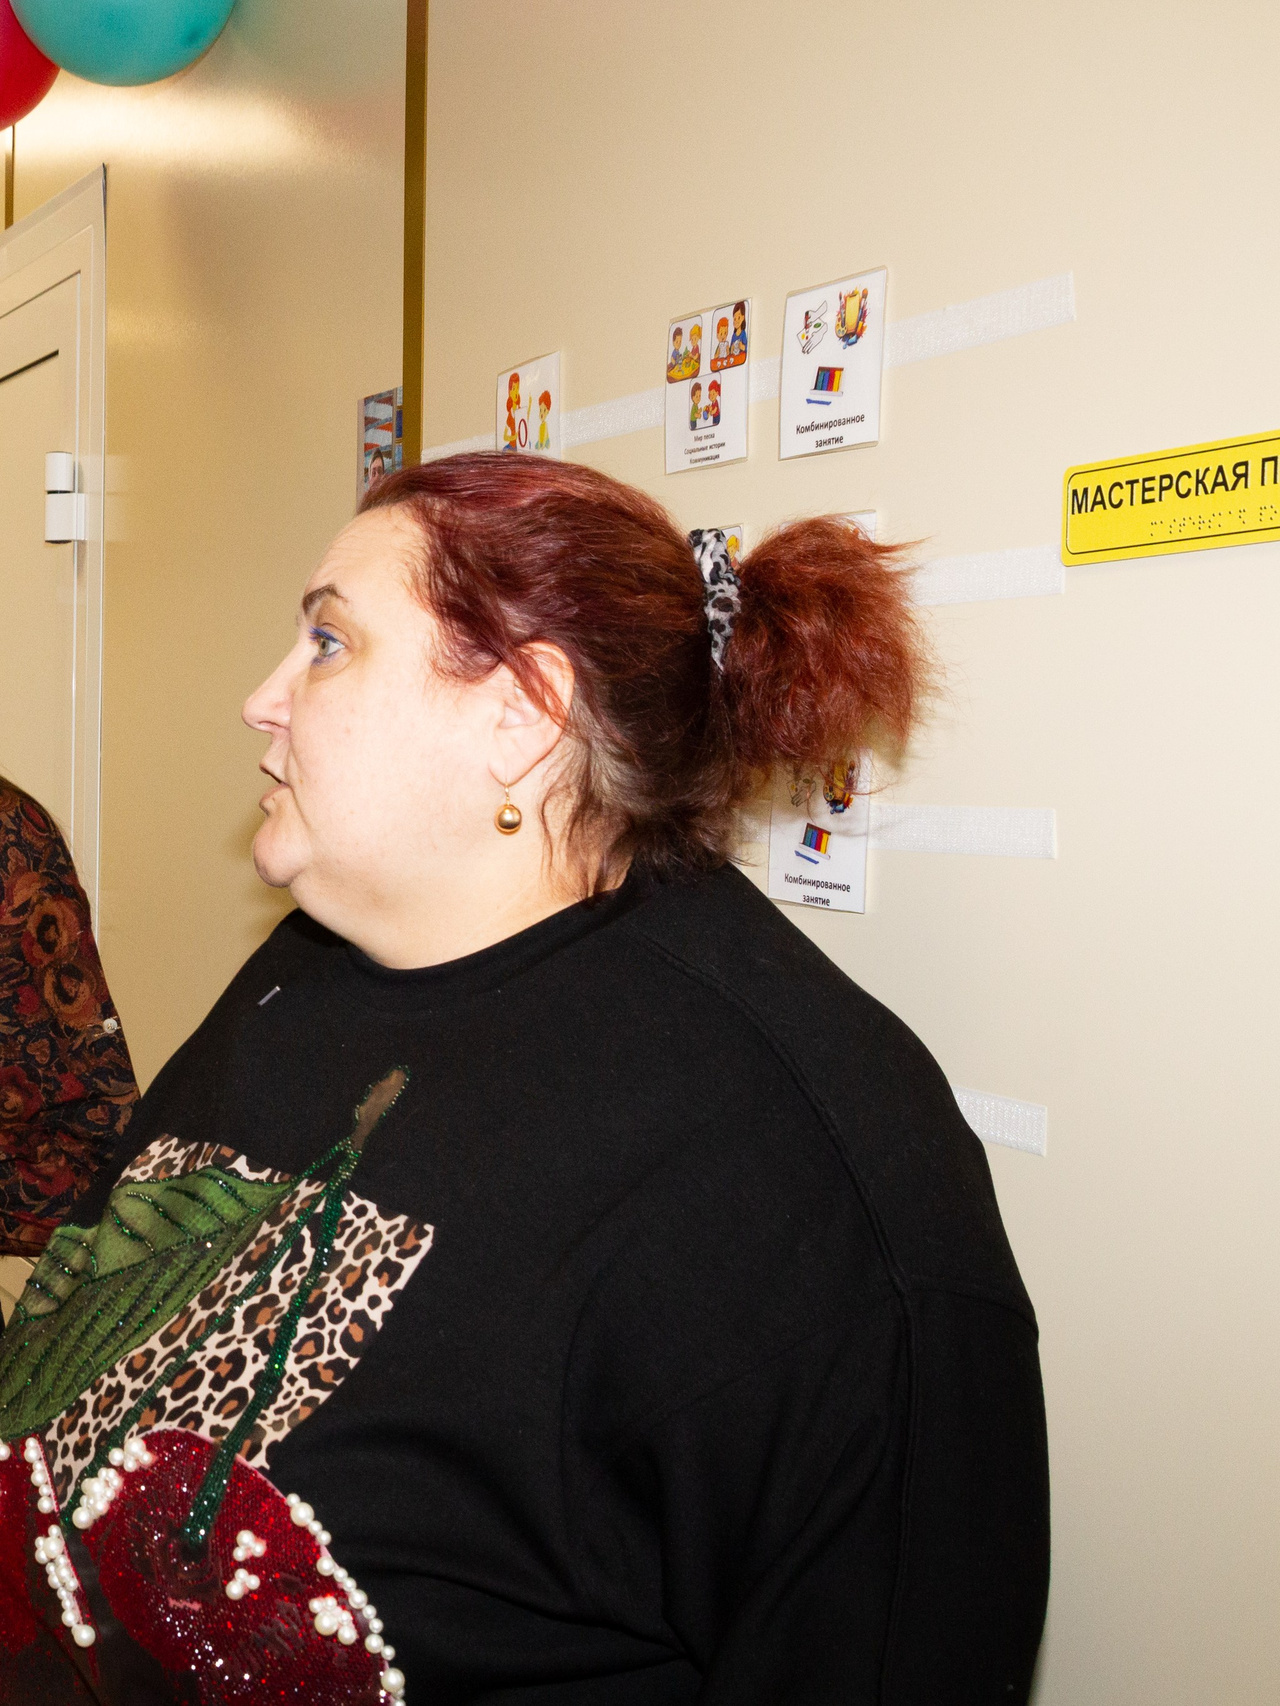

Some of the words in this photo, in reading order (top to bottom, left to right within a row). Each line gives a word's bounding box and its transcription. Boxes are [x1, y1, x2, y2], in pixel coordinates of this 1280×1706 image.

[796, 413, 865, 435] Комбинированное
[815, 435, 844, 449] занятие
[1071, 460, 1249, 515] МАСТЕРСКАЯ
[1261, 455, 1279, 486] П
[784, 873, 851, 892] Комбинированное
[802, 894, 830, 906] занятие
